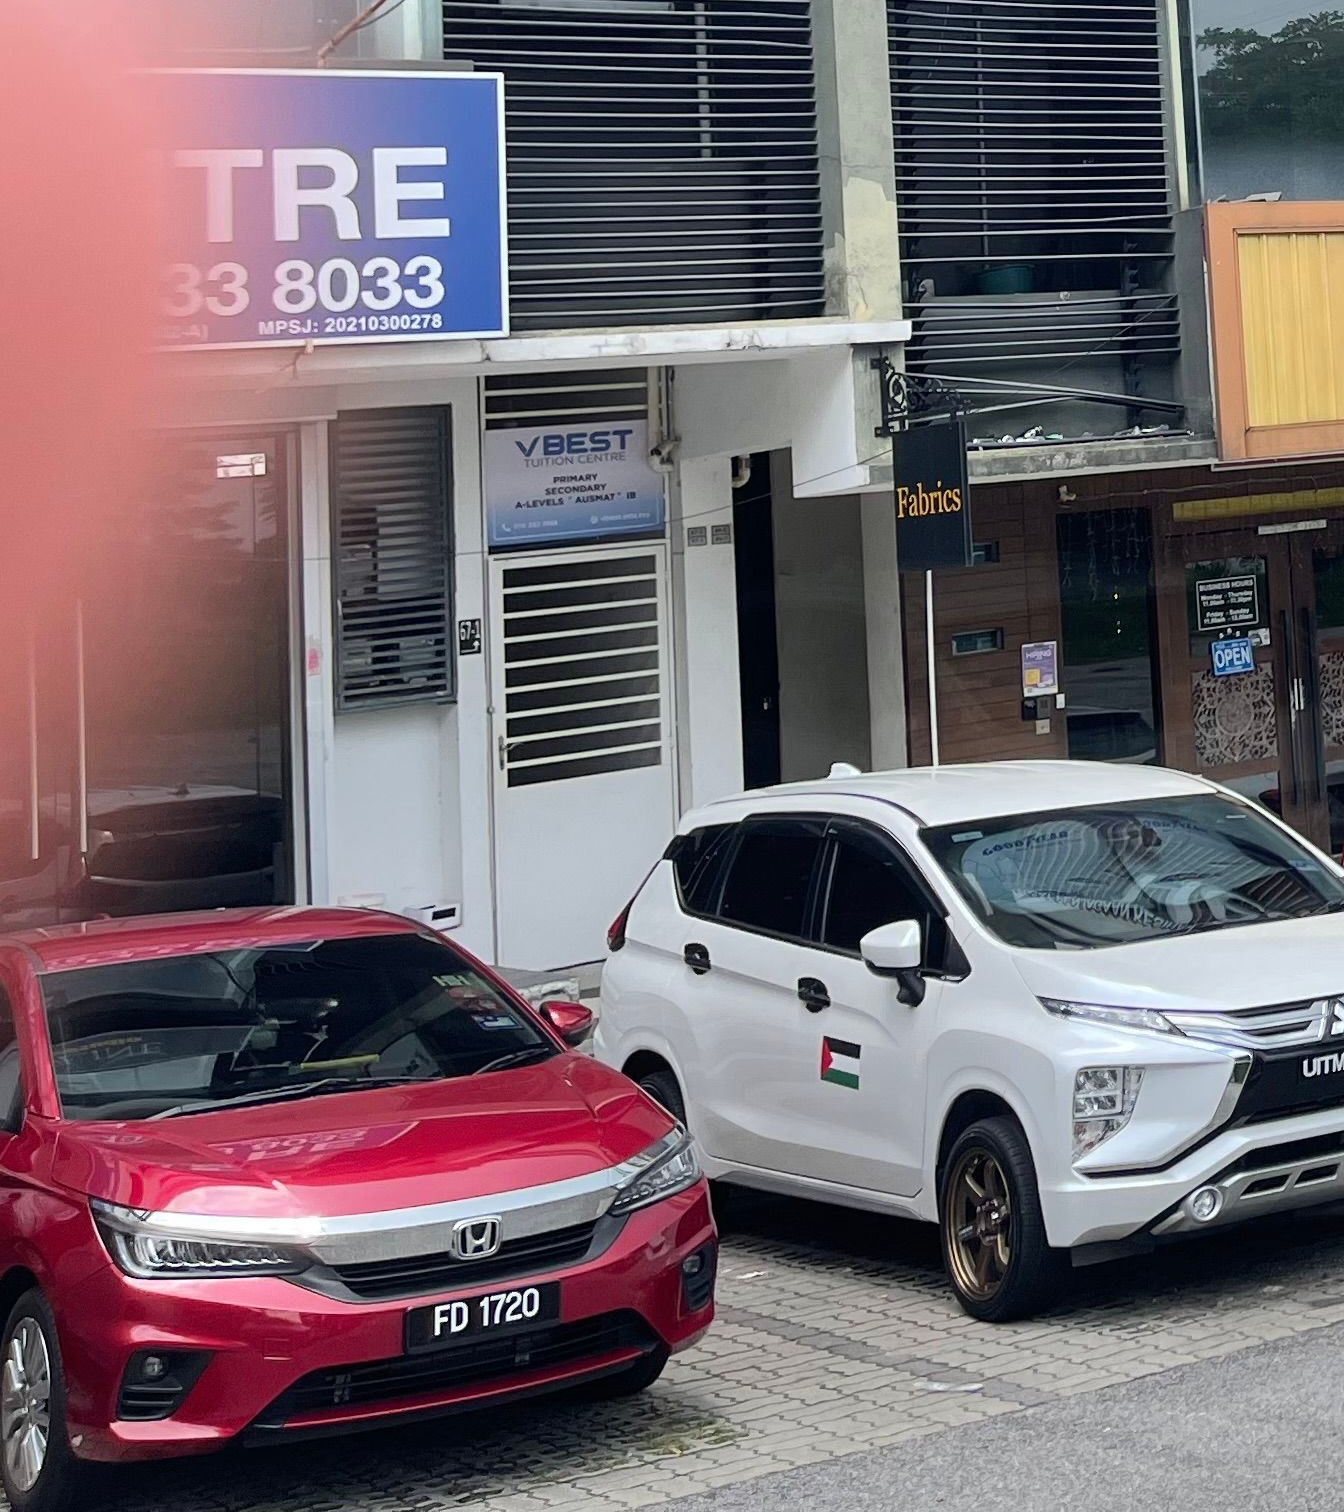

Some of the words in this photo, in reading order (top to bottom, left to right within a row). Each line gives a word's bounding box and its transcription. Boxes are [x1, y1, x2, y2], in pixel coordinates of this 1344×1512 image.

[173, 146, 451, 244] TRE
[271, 254, 446, 315] 8033
[257, 317, 320, 335] MPSJ:
[323, 313, 443, 334] 20210300278
[514, 429, 634, 458] VBEST
[524, 456, 575, 469] TUITION
[577, 451, 627, 465] CENTRE
[545, 483, 608, 496] SECONDARY
[553, 473, 599, 484] PRIMARY
[514, 497, 565, 510] A-LEVELS
[575, 492, 616, 504] AUSMAT
[896, 480, 963, 519] Fabrics
[1215, 646, 1251, 669] OPEN
[432, 1300, 471, 1336] FD
[478, 1287, 541, 1328] 1720
